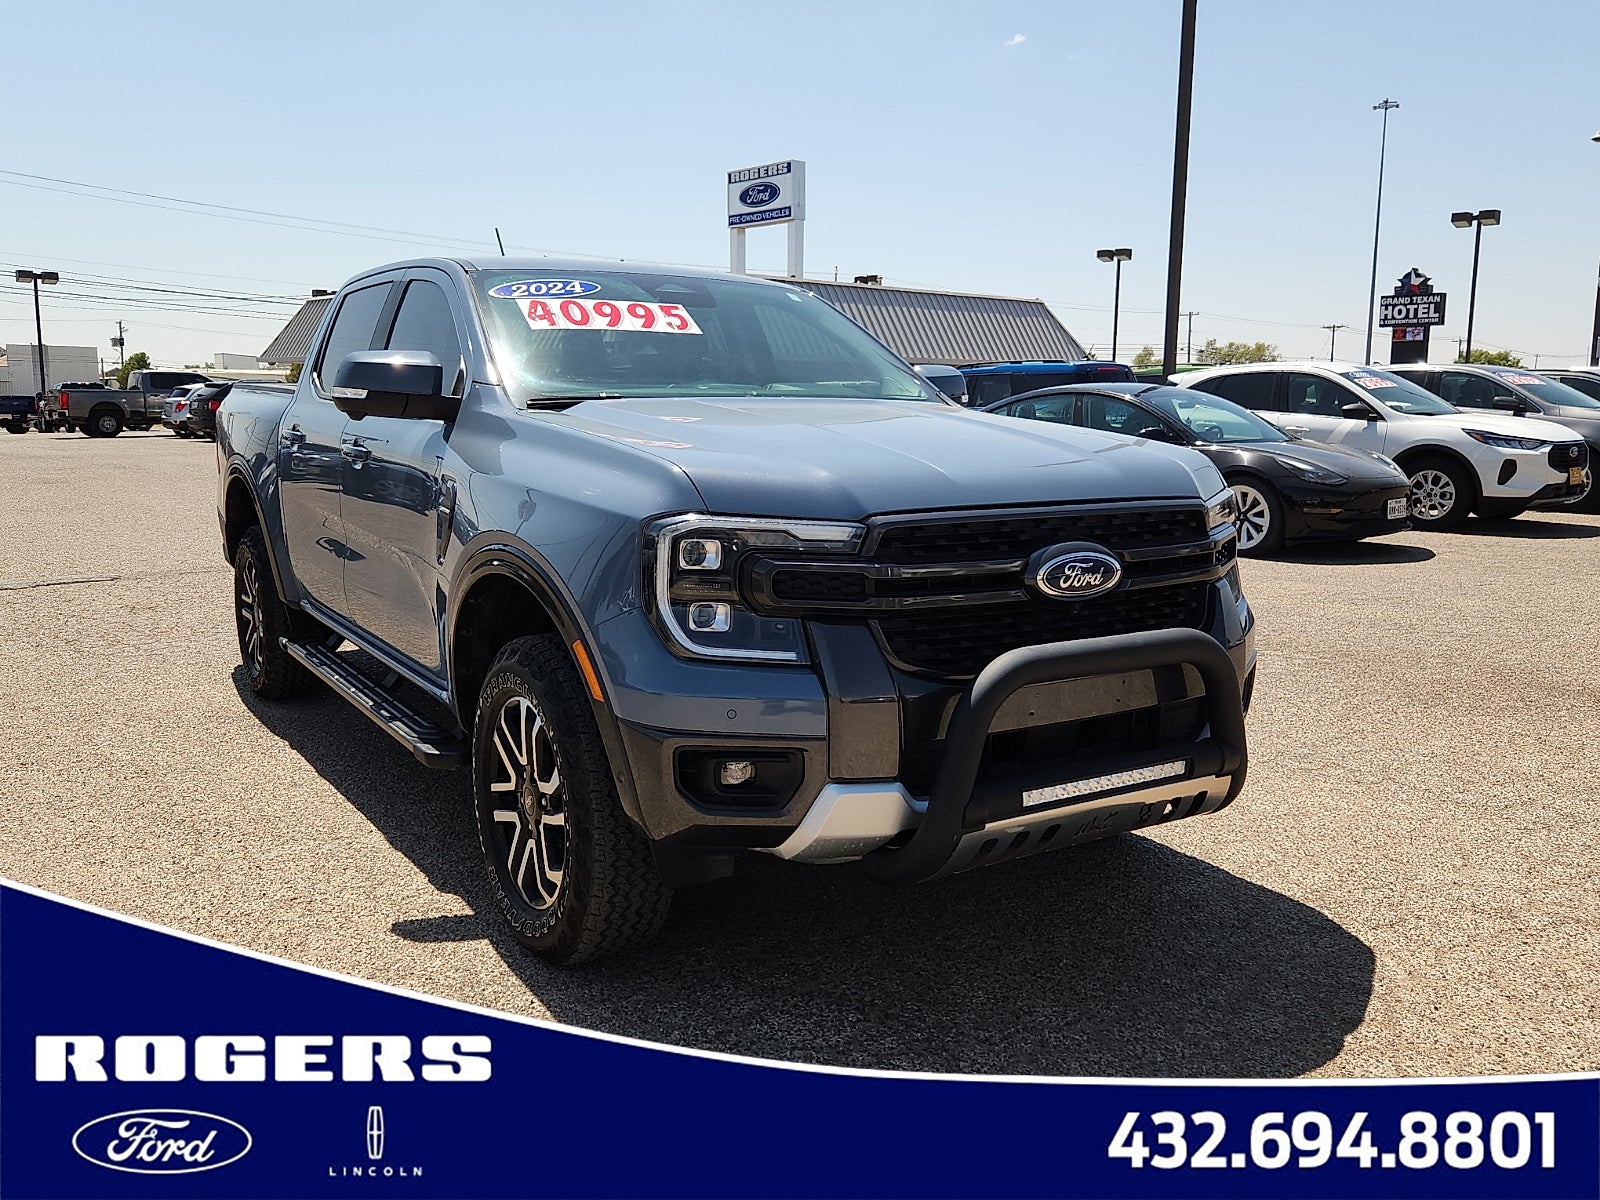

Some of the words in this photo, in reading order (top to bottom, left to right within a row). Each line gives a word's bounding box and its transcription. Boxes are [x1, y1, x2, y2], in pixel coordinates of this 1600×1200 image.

[730, 162, 788, 183] ROGERS
[746, 185, 771, 204] Ford
[729, 214, 762, 223] PRE-OWNED
[762, 208, 789, 218] VEHICLES
[511, 280, 585, 296] 2024
[1381, 297, 1410, 305] GRAND
[1412, 295, 1440, 304] TEXAN
[527, 299, 690, 331] 40995
[1380, 304, 1439, 319] HOTEL
[1059, 562, 1105, 589] Ford
